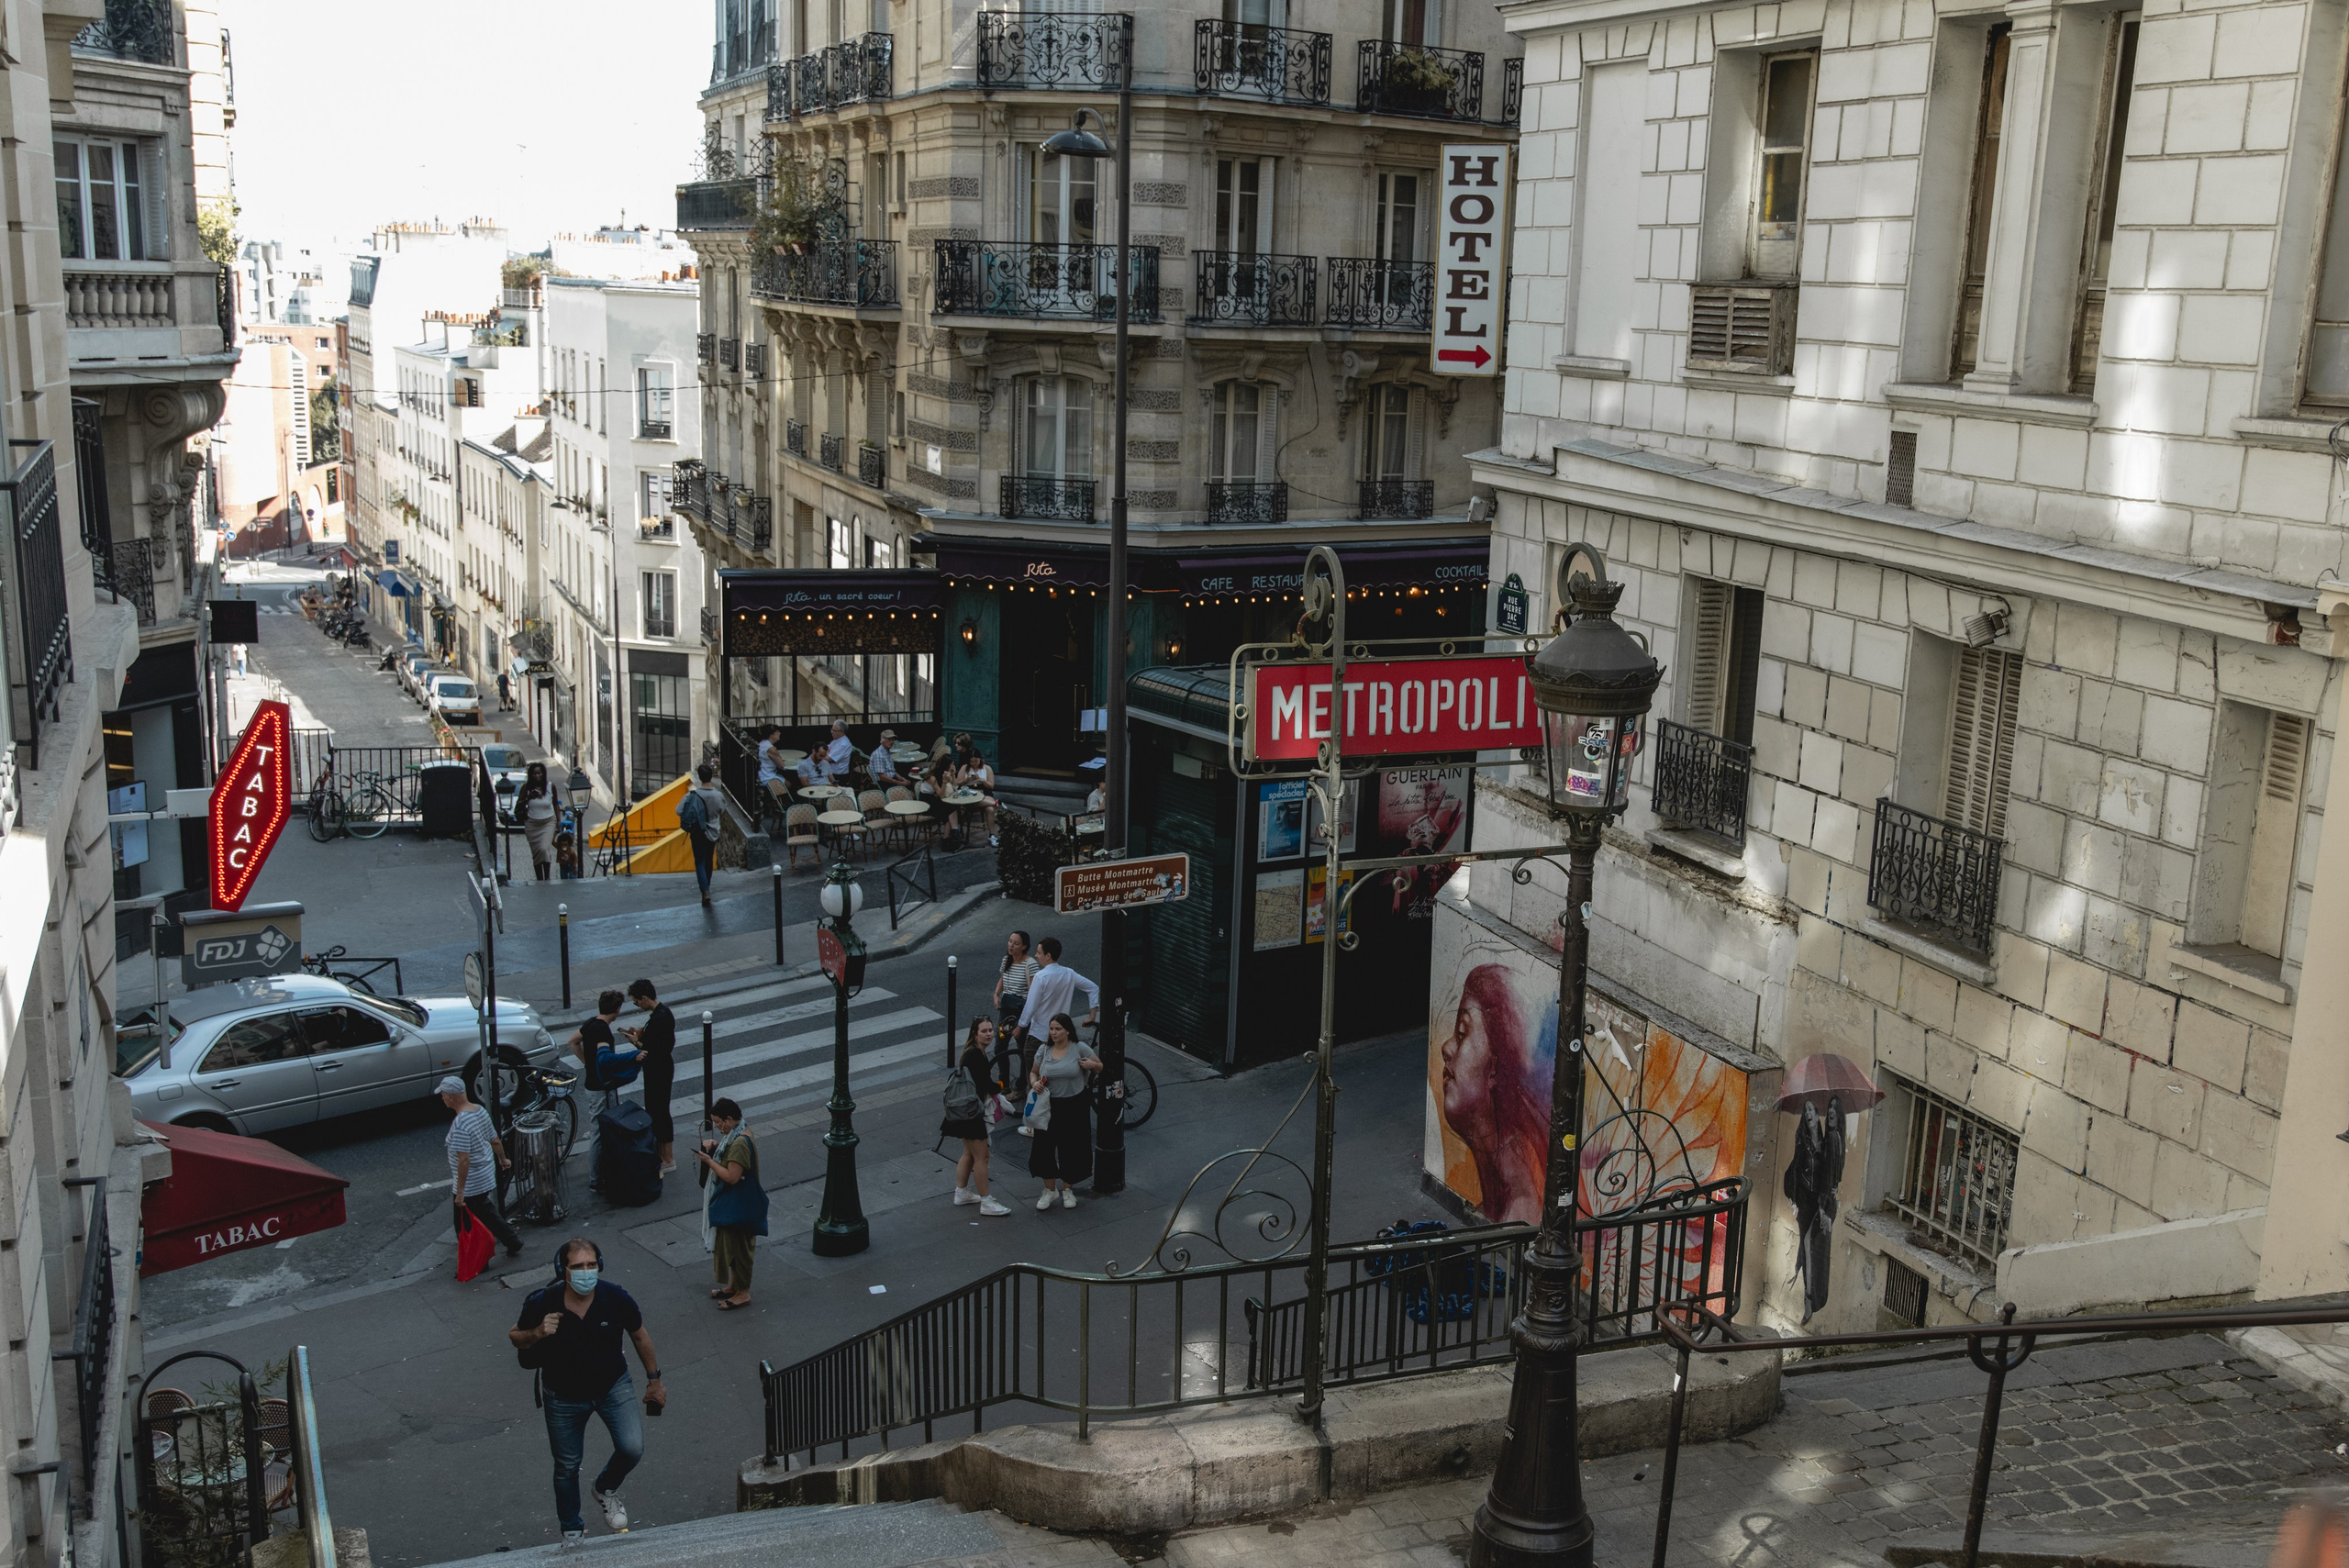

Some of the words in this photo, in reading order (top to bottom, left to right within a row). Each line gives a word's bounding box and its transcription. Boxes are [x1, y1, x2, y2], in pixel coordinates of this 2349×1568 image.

[1444, 155, 1499, 338] HOTEL
[1023, 562, 1057, 578] Rita
[1201, 577, 1234, 590] CAFE
[837, 592, 863, 600] sacré
[1508, 595, 1519, 606] RUE
[1503, 603, 1521, 615] PIERRE
[1507, 612, 1517, 621] DAC
[1271, 675, 1542, 741] METROPOLI
[1386, 768, 1462, 785] GUERLAIN
[1415, 783, 1432, 791] PARIS
[228, 744, 274, 869] TABAC
[1077, 873, 1101, 883] Butte
[1104, 867, 1153, 880] Montmartre
[1077, 884, 1105, 895] Musée
[1108, 877, 1156, 890] Montmartre
[1142, 887, 1166, 897] Saule
[200, 939, 247, 962] FDJ
[194, 1216, 281, 1255] TABAC
